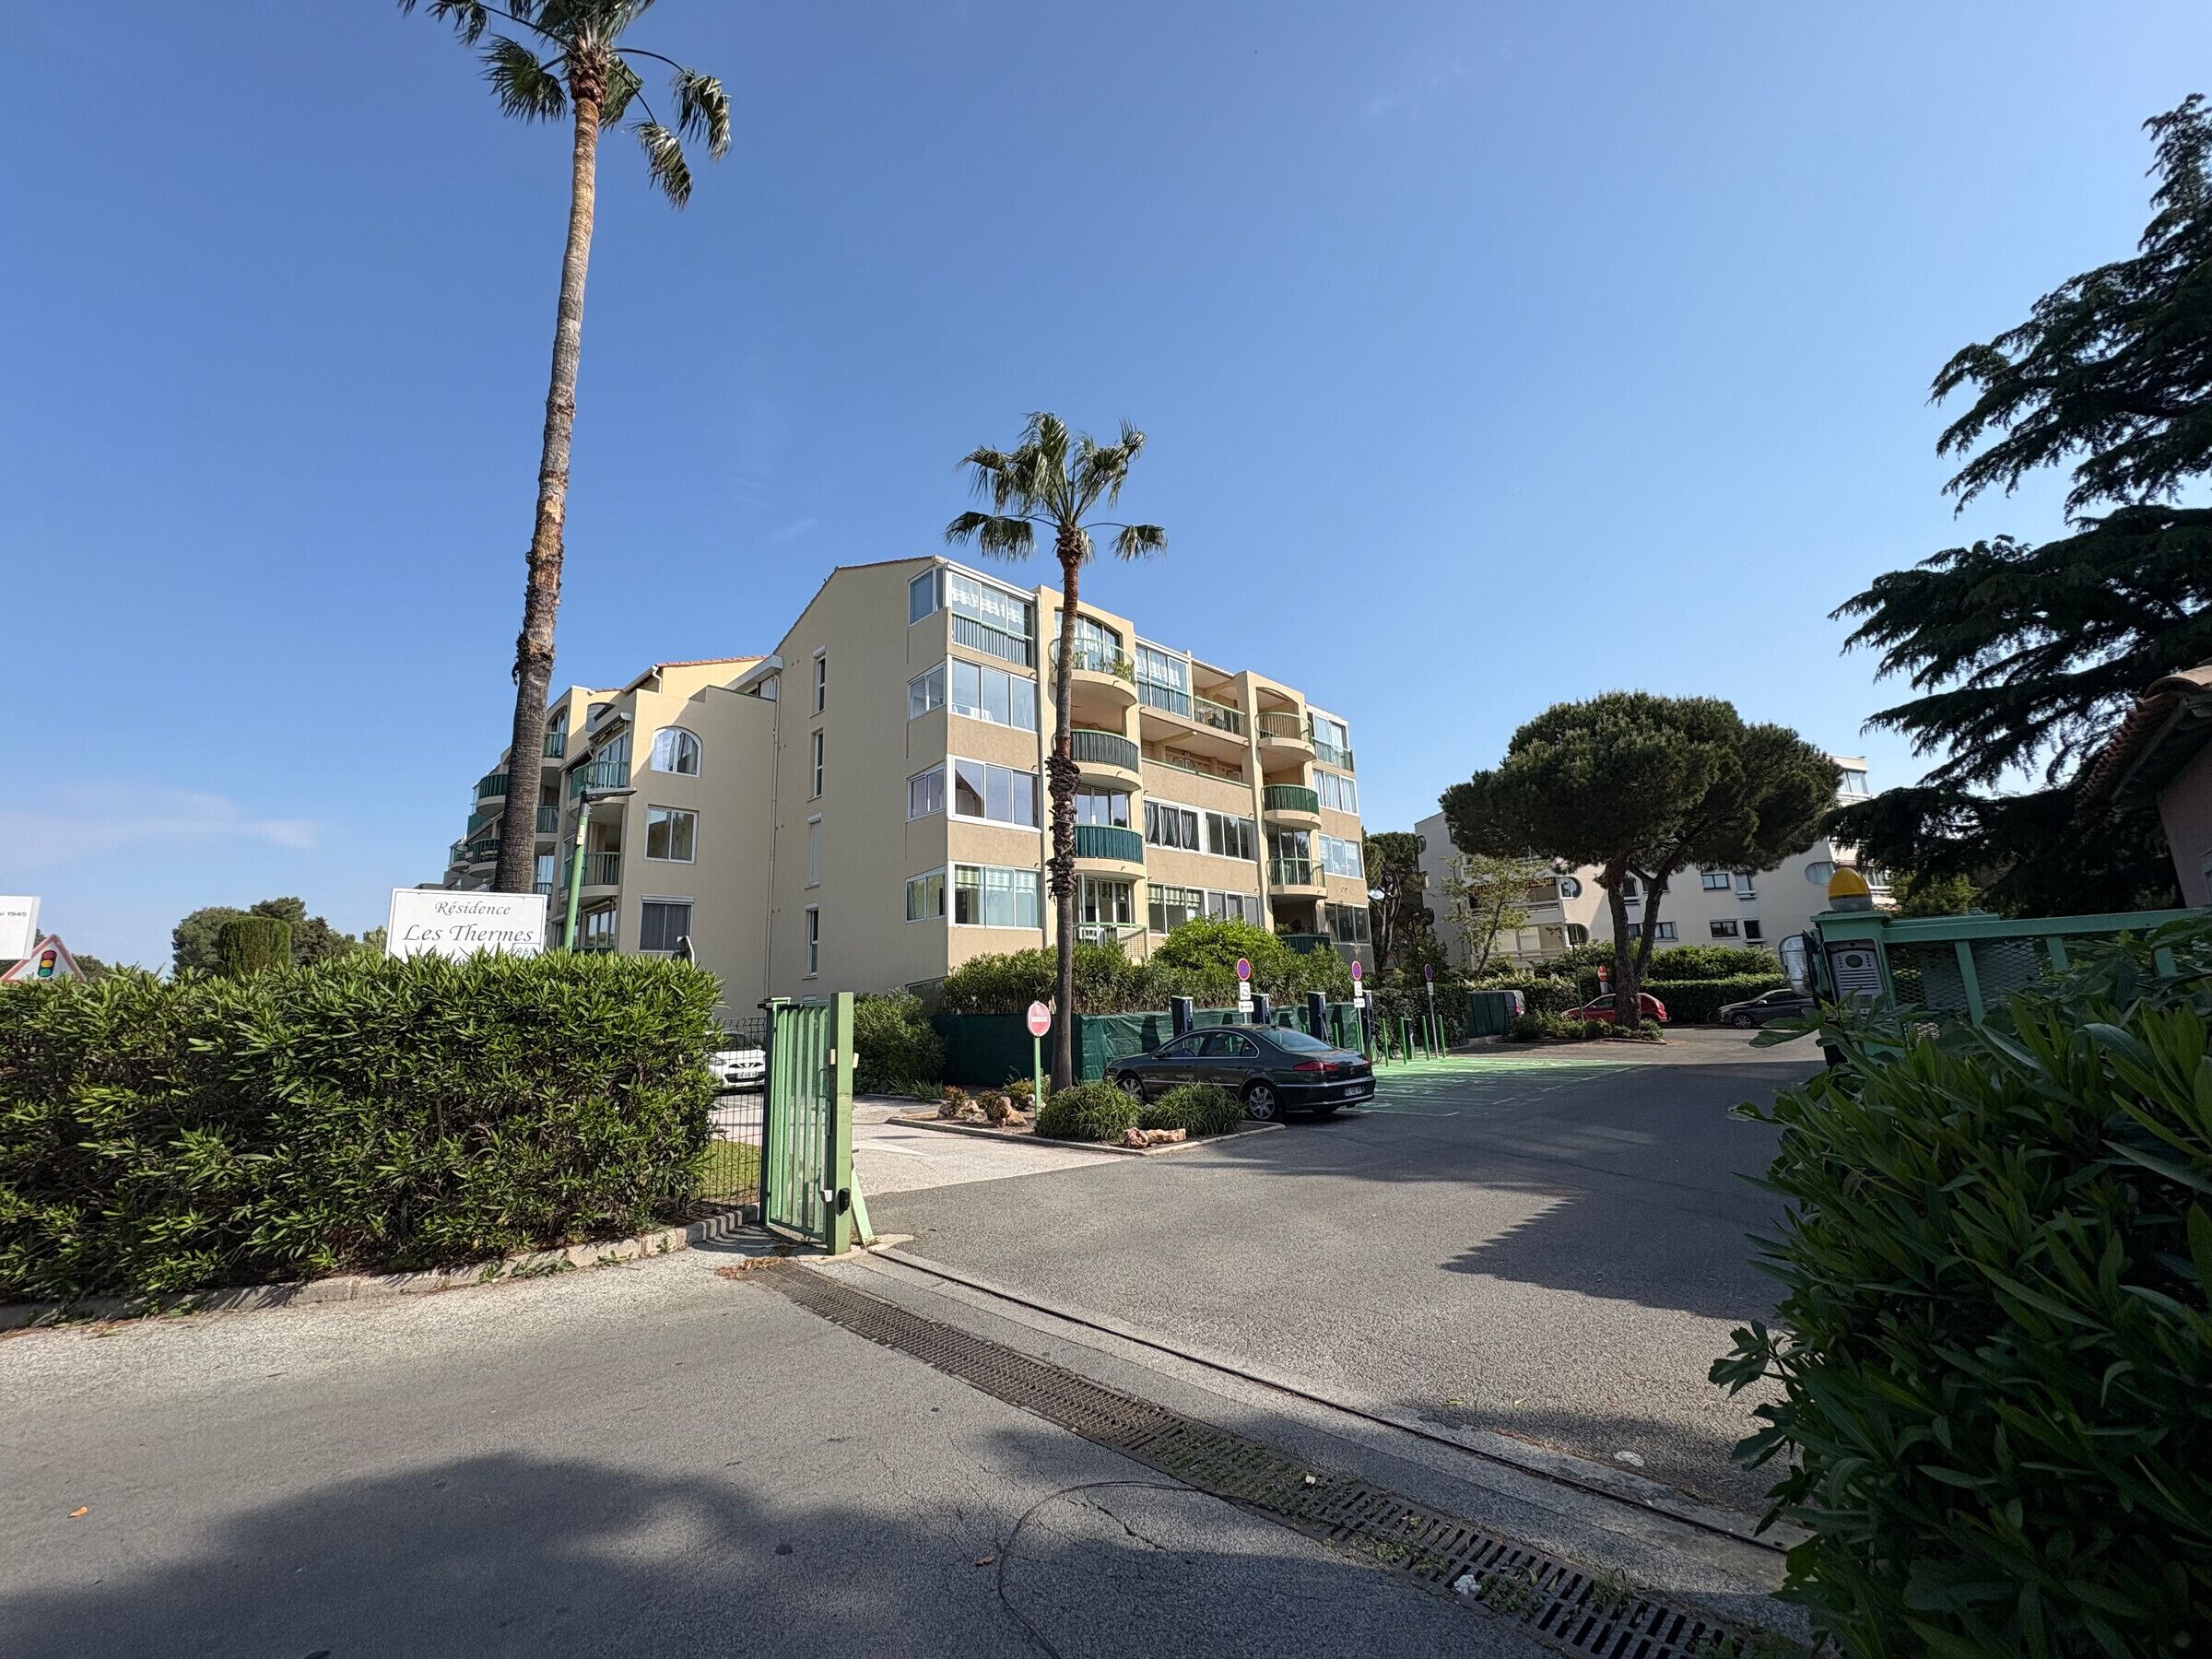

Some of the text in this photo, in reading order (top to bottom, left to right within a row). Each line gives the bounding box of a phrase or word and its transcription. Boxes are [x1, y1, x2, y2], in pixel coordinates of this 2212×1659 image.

[435, 900, 511, 916] Résidence
[403, 924, 534, 942] Les Thermes
